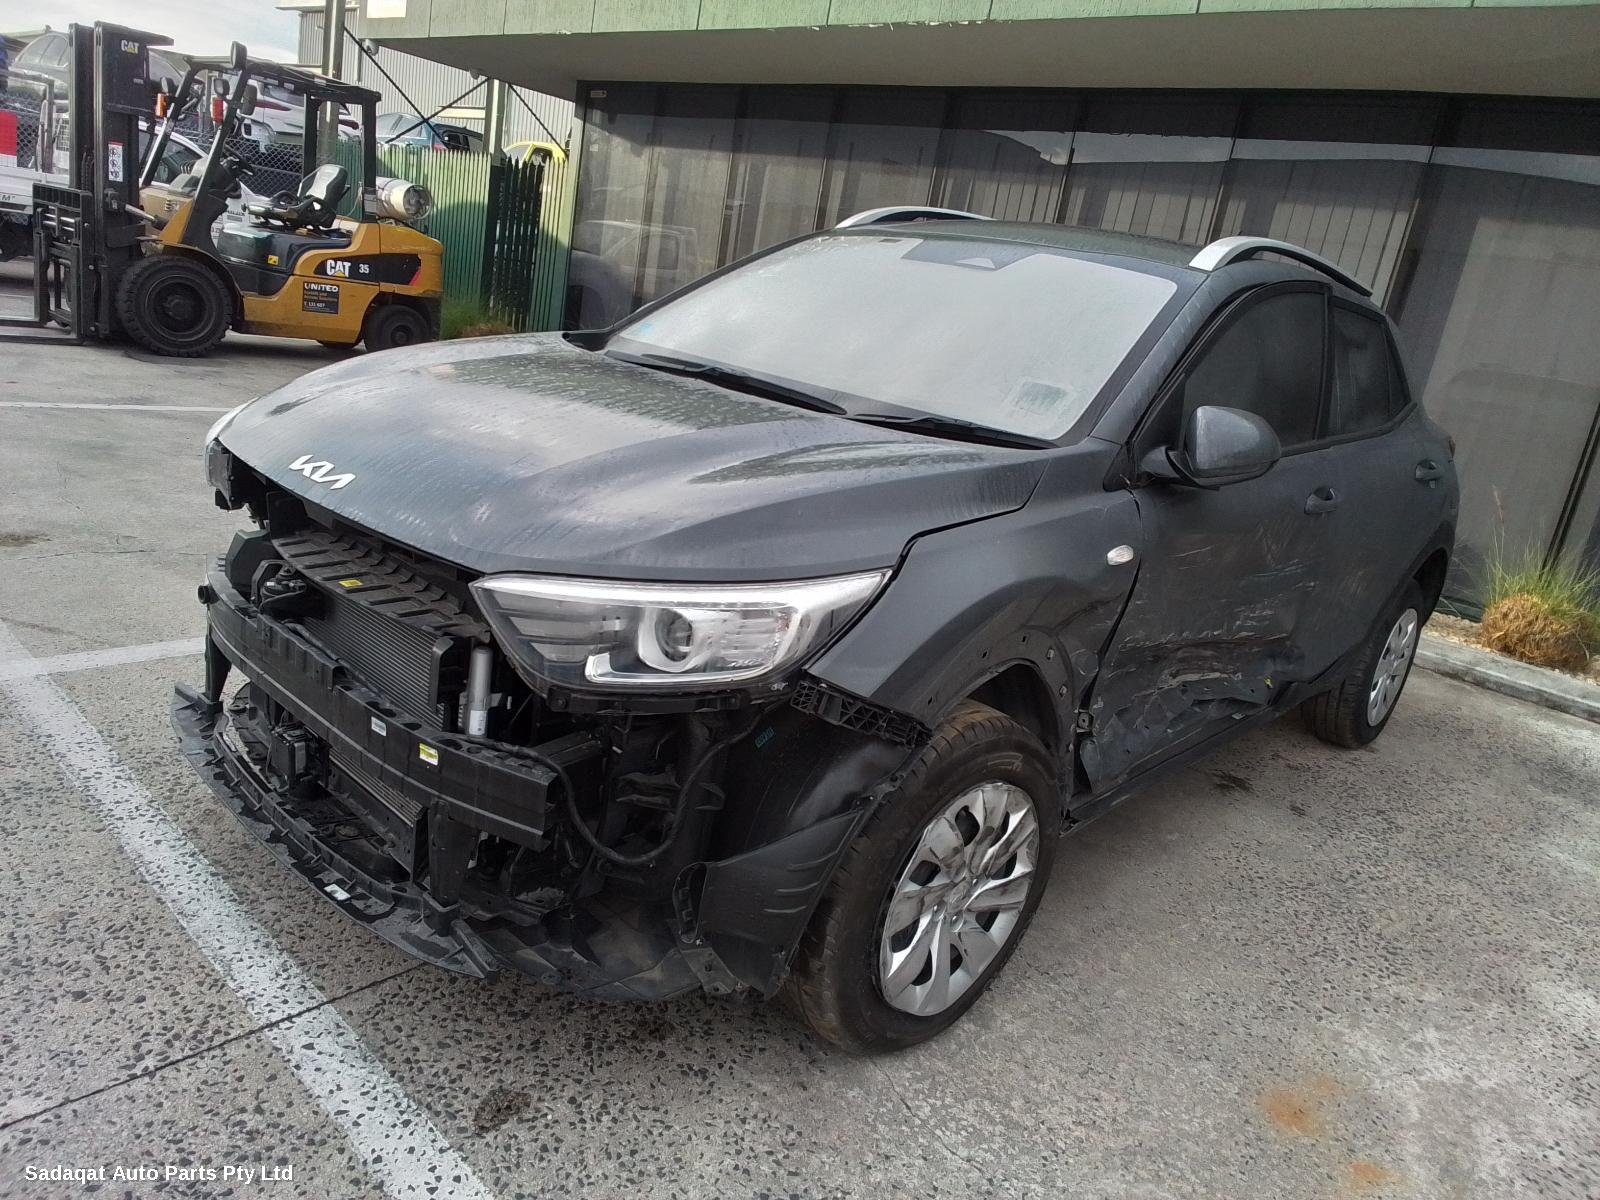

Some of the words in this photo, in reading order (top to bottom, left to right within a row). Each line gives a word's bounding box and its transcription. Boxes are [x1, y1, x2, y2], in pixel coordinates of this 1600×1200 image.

[121, 40, 139, 54] CAT
[326, 259, 351, 278] CAT
[359, 264, 369, 274] 35
[304, 283, 339, 293] UNITED
[288, 454, 356, 490] KIA
